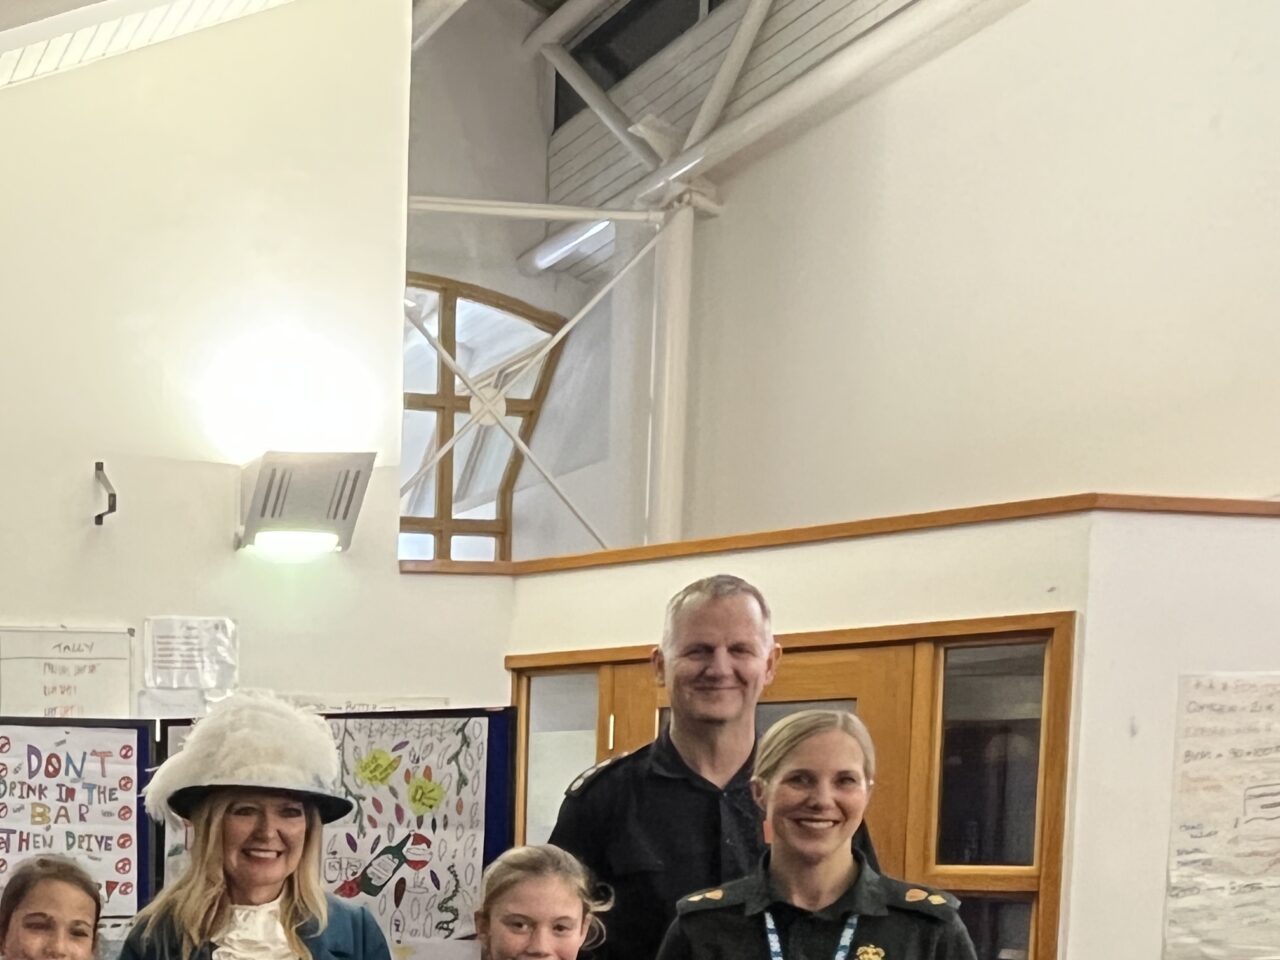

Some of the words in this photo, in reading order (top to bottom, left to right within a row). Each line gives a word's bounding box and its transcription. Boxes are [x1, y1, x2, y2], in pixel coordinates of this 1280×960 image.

[51, 641, 94, 653] TALLY
[55, 783, 76, 803] IN
[81, 782, 119, 806] THE
[29, 801, 90, 826] BAR
[64, 830, 114, 852] DRIVE
